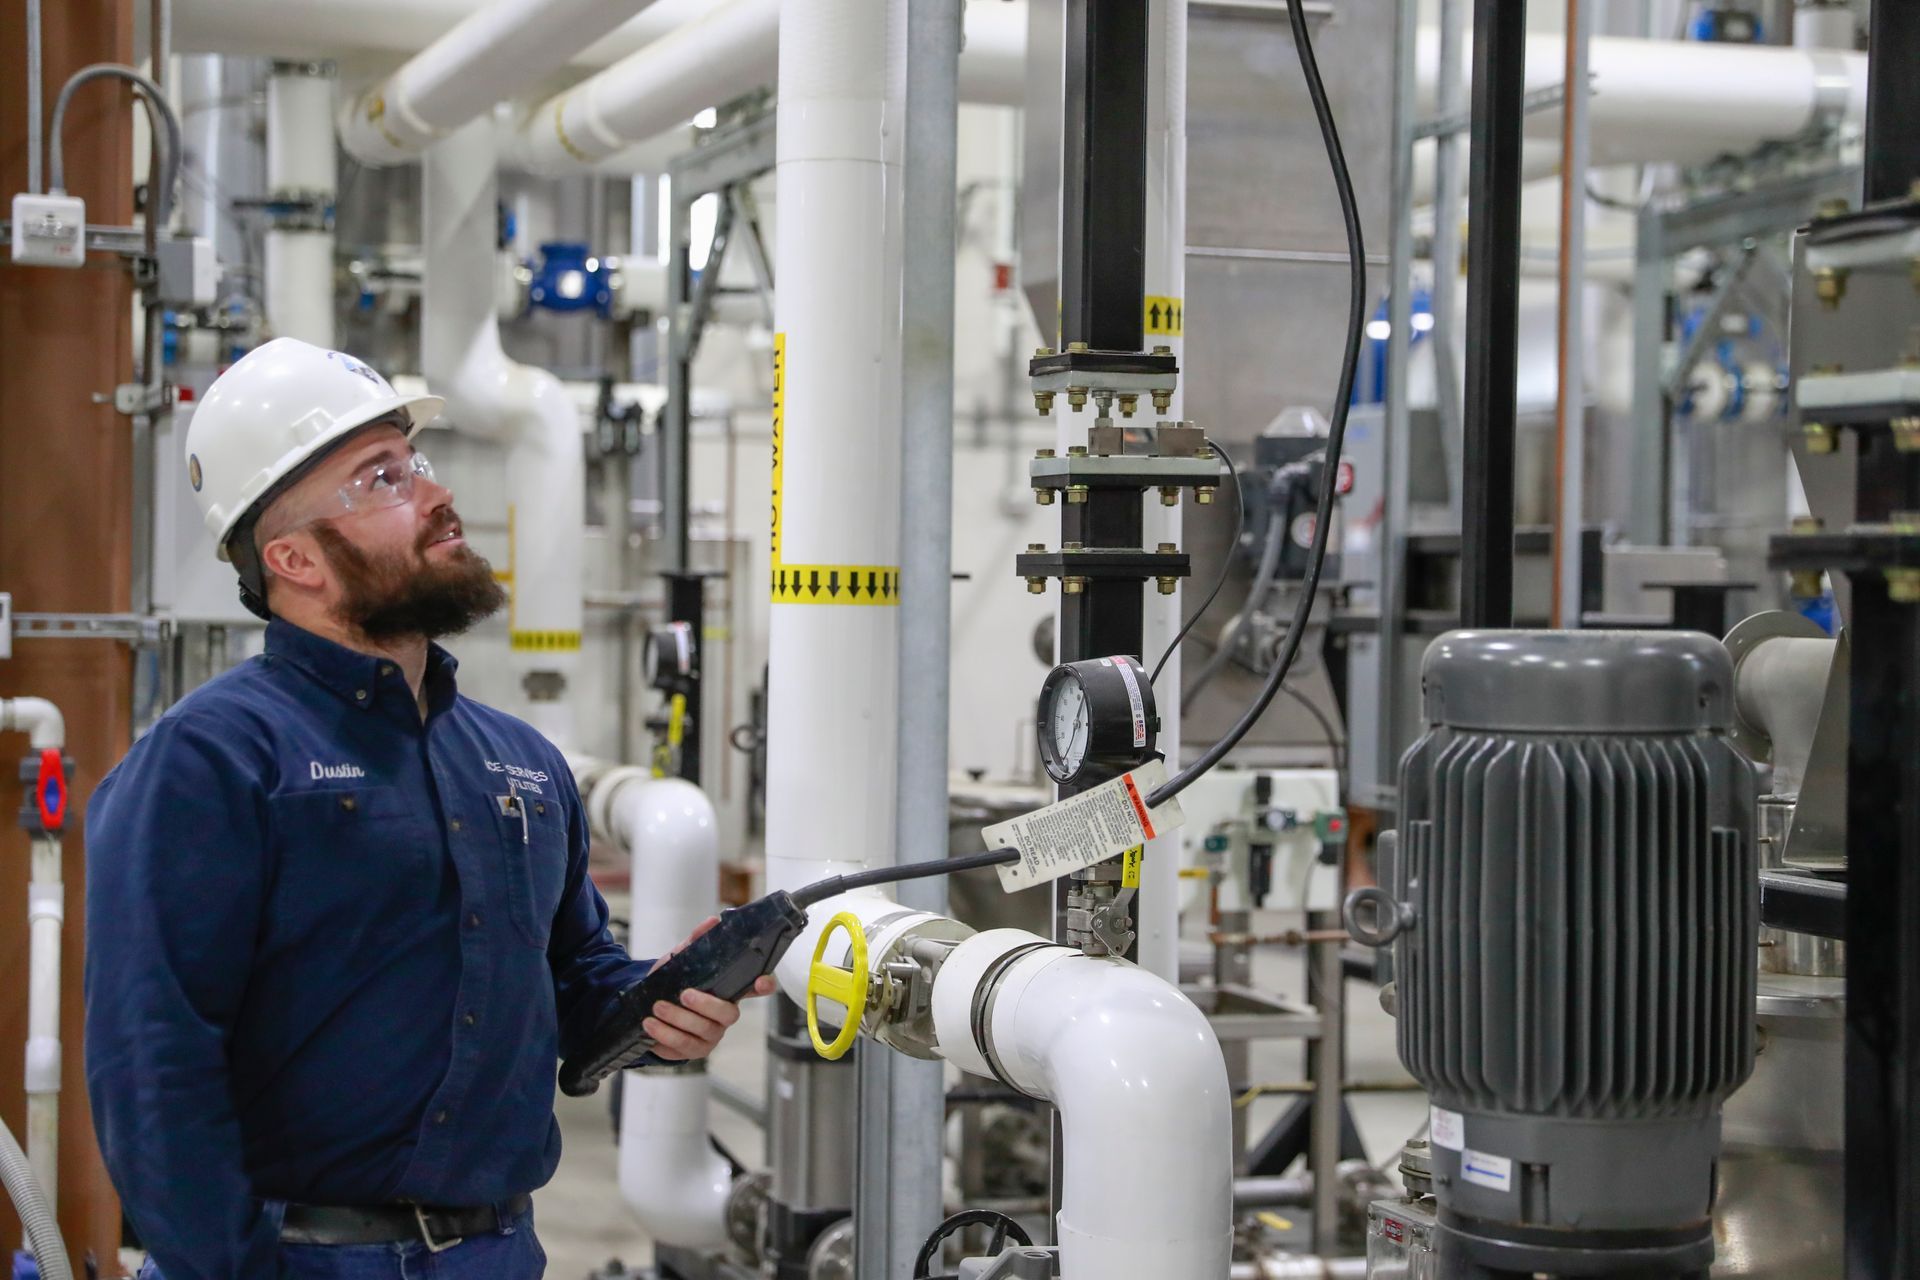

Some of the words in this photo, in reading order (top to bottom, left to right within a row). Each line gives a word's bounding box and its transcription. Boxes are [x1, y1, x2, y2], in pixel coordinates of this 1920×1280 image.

[310, 761, 365, 780] Dustin
[1121, 799, 1130, 810] DO
[1131, 795, 1149, 827] WARNING
[1125, 810, 1136, 825] NOT
[1023, 835, 1032, 846] DO
[1028, 846, 1040, 865] READ
